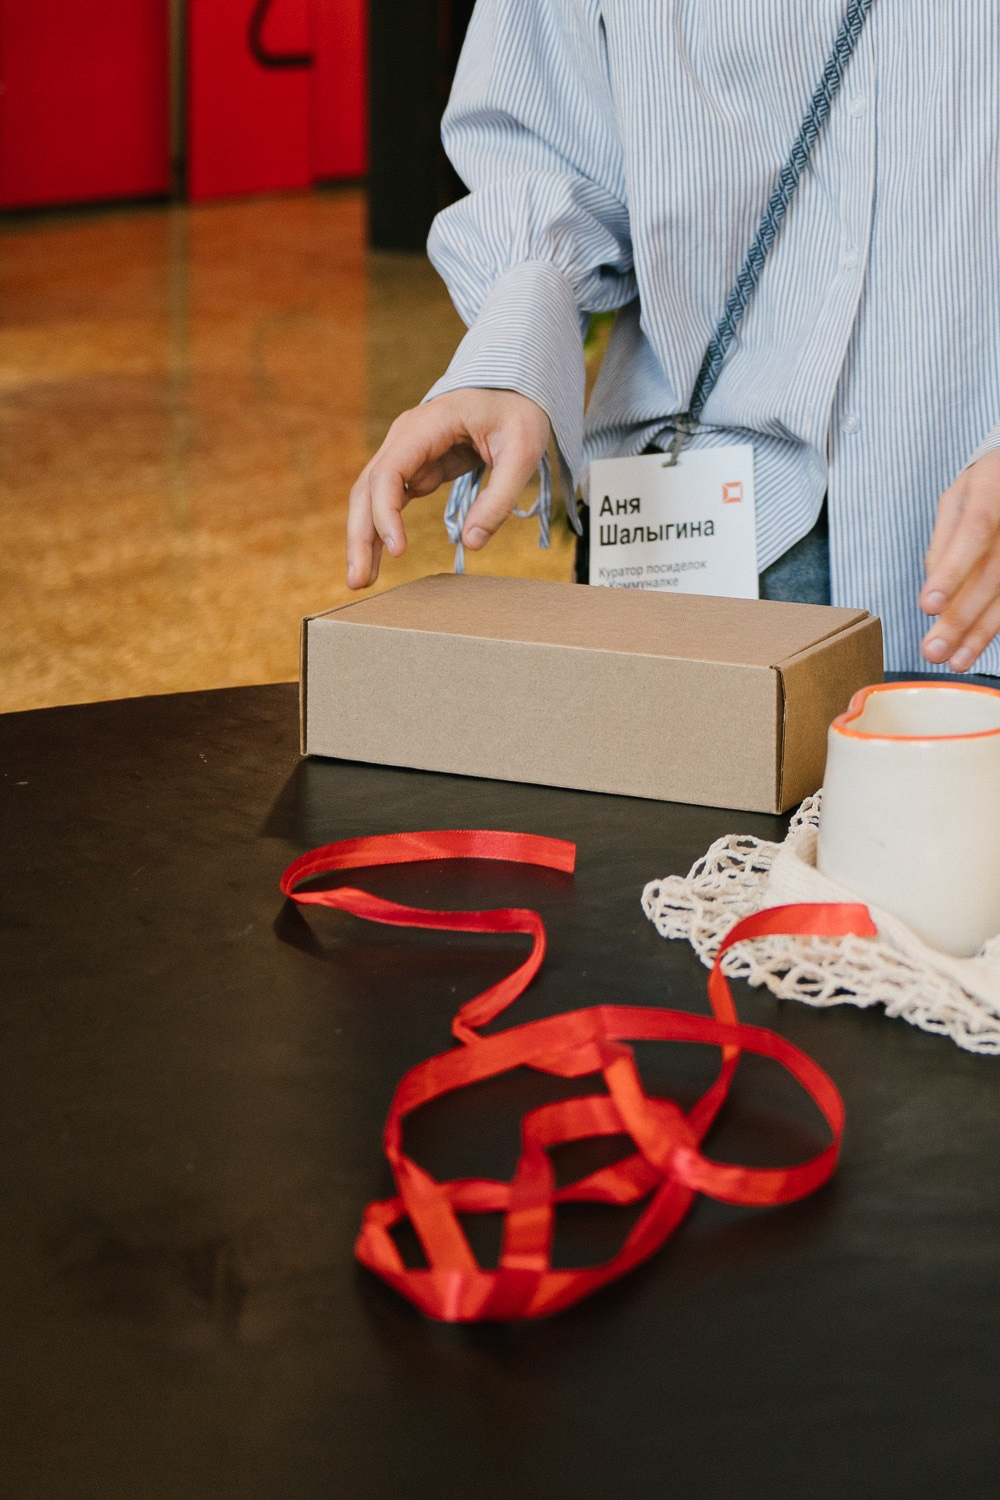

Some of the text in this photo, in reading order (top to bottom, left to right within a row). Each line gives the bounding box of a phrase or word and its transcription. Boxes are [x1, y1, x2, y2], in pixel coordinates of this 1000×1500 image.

[599, 495, 641, 517] Аня
[600, 520, 715, 546] Шалыгина
[599, 560, 707, 578] Куратор посиделок
